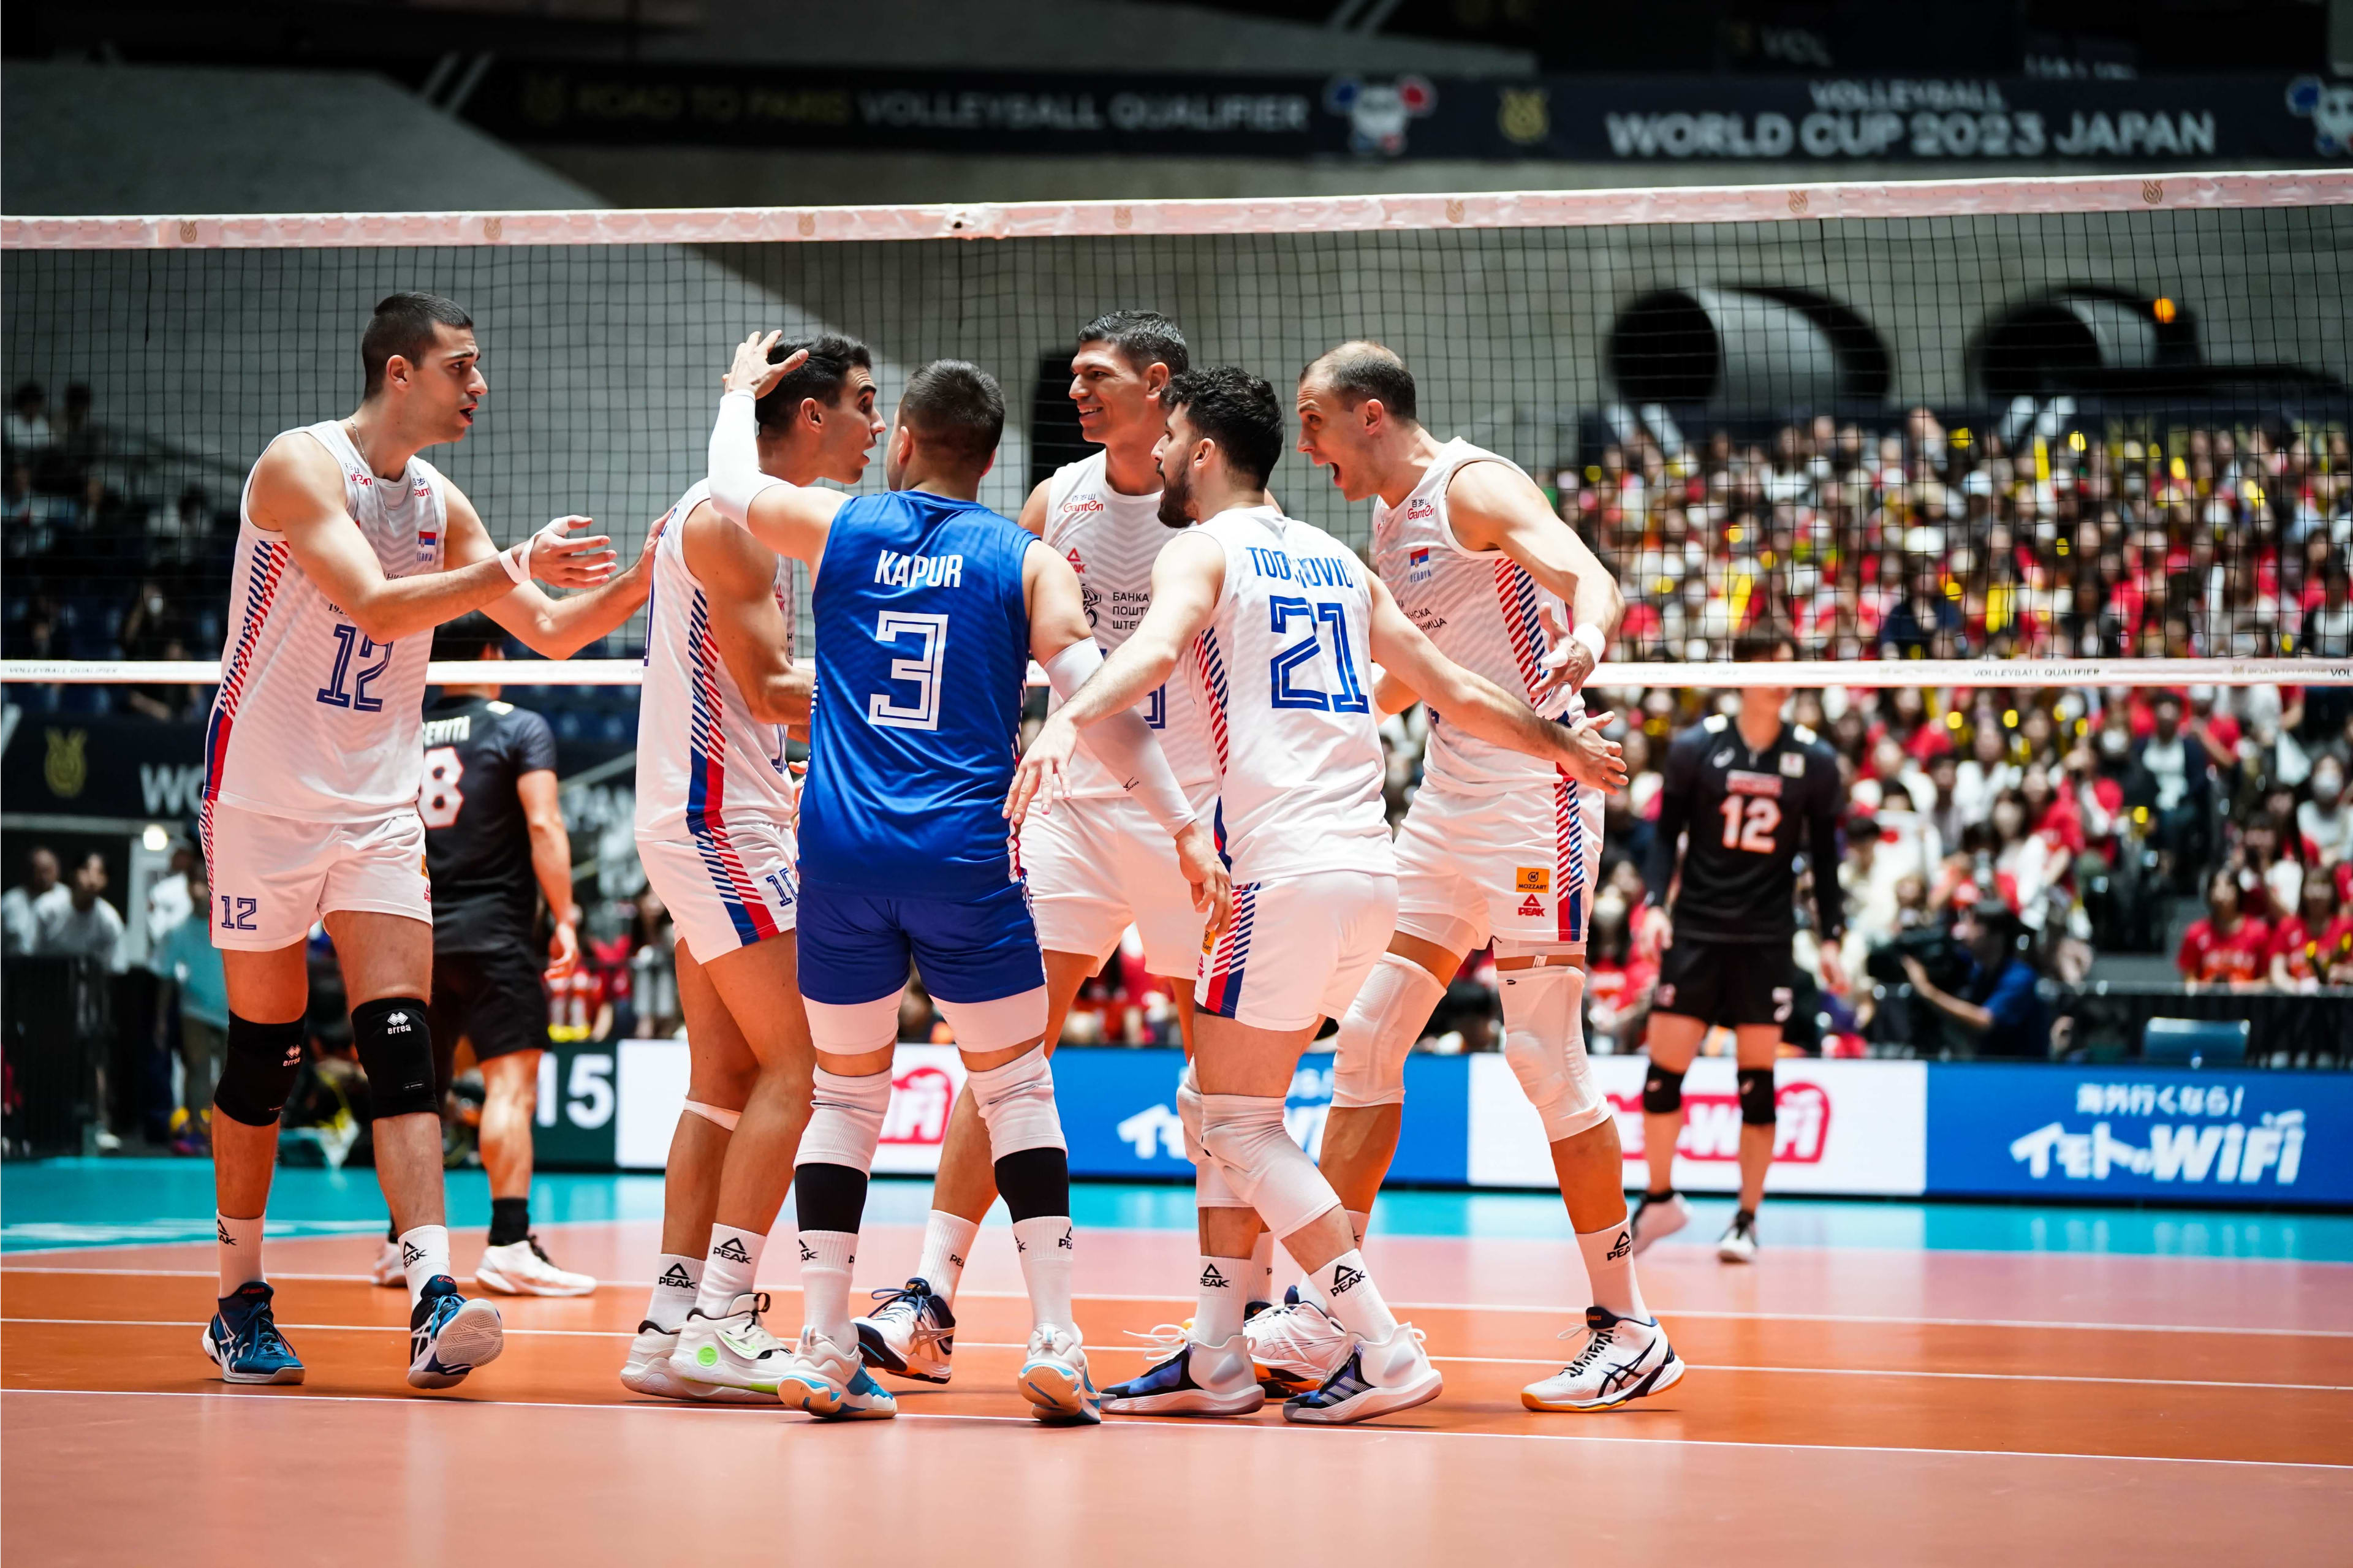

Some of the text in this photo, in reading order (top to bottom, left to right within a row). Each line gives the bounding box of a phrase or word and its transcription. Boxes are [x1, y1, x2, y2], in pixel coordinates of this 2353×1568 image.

[858, 89, 1102, 129] VOLLEYBALL
[1108, 92, 1311, 130] QUALIFIER
[1809, 80, 2009, 112] VOLLEYBALL
[1604, 109, 2216, 157] WORLD CUP 2023 JAPAN
[874, 550, 963, 588] KAPUR
[1074, 564, 1087, 574] AK
[1245, 547, 1354, 588] TODOVIĆ
[1113, 592, 1150, 602] БАНКА
[1113, 606, 1149, 616] ПОШТ
[316, 623, 394, 712] 12
[1270, 594, 1370, 714] 21
[868, 610, 949, 730] 3
[1972, 668, 2039, 677] VOLLEYBALL
[2044, 667, 2100, 676] QUALIFIER
[418, 746, 464, 829] 8
[1719, 794, 1783, 854] 12
[221, 895, 257, 930] 12
[1518, 907, 1545, 917] PEAK
[536, 1051, 614, 1130] 15
[219, 1234, 237, 1246] AK
[1607, 1244, 1632, 1261] PEA
[403, 1249, 428, 1269] EAK
[713, 1246, 752, 1264] PEAK
[801, 1251, 819, 1262] AK
[658, 1276, 696, 1289] PEAK
[1200, 1278, 1230, 1287] PEAK
[1330, 1270, 1366, 1297] PEAK
